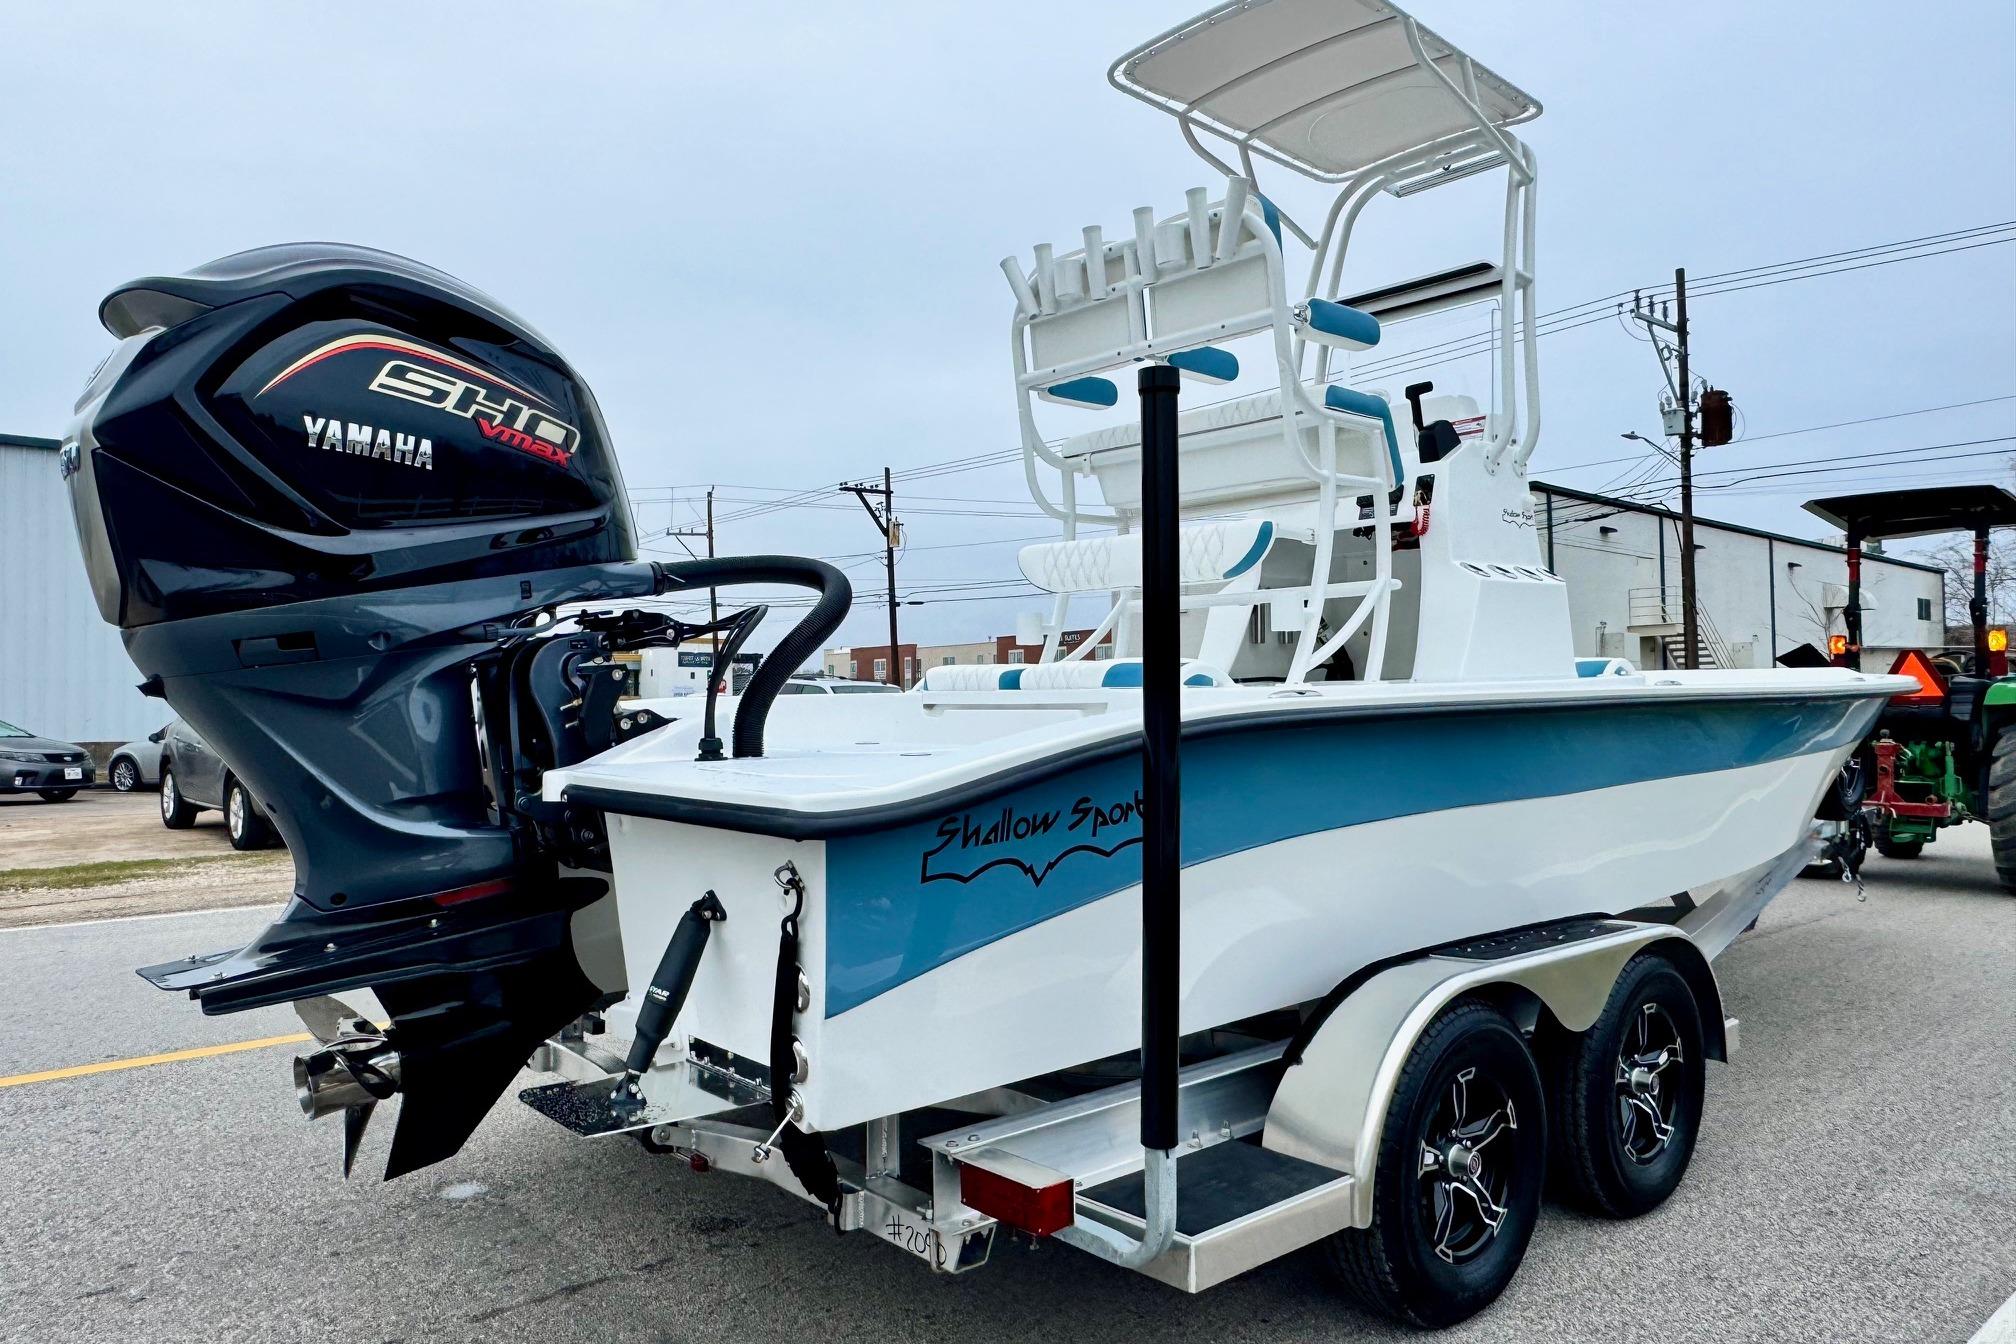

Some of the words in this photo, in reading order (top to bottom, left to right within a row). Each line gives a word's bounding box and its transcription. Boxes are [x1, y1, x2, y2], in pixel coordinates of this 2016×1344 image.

[368, 360, 581, 453] SHO
[303, 415, 433, 470] YAMAHA
[927, 808, 1061, 856] Shallow
